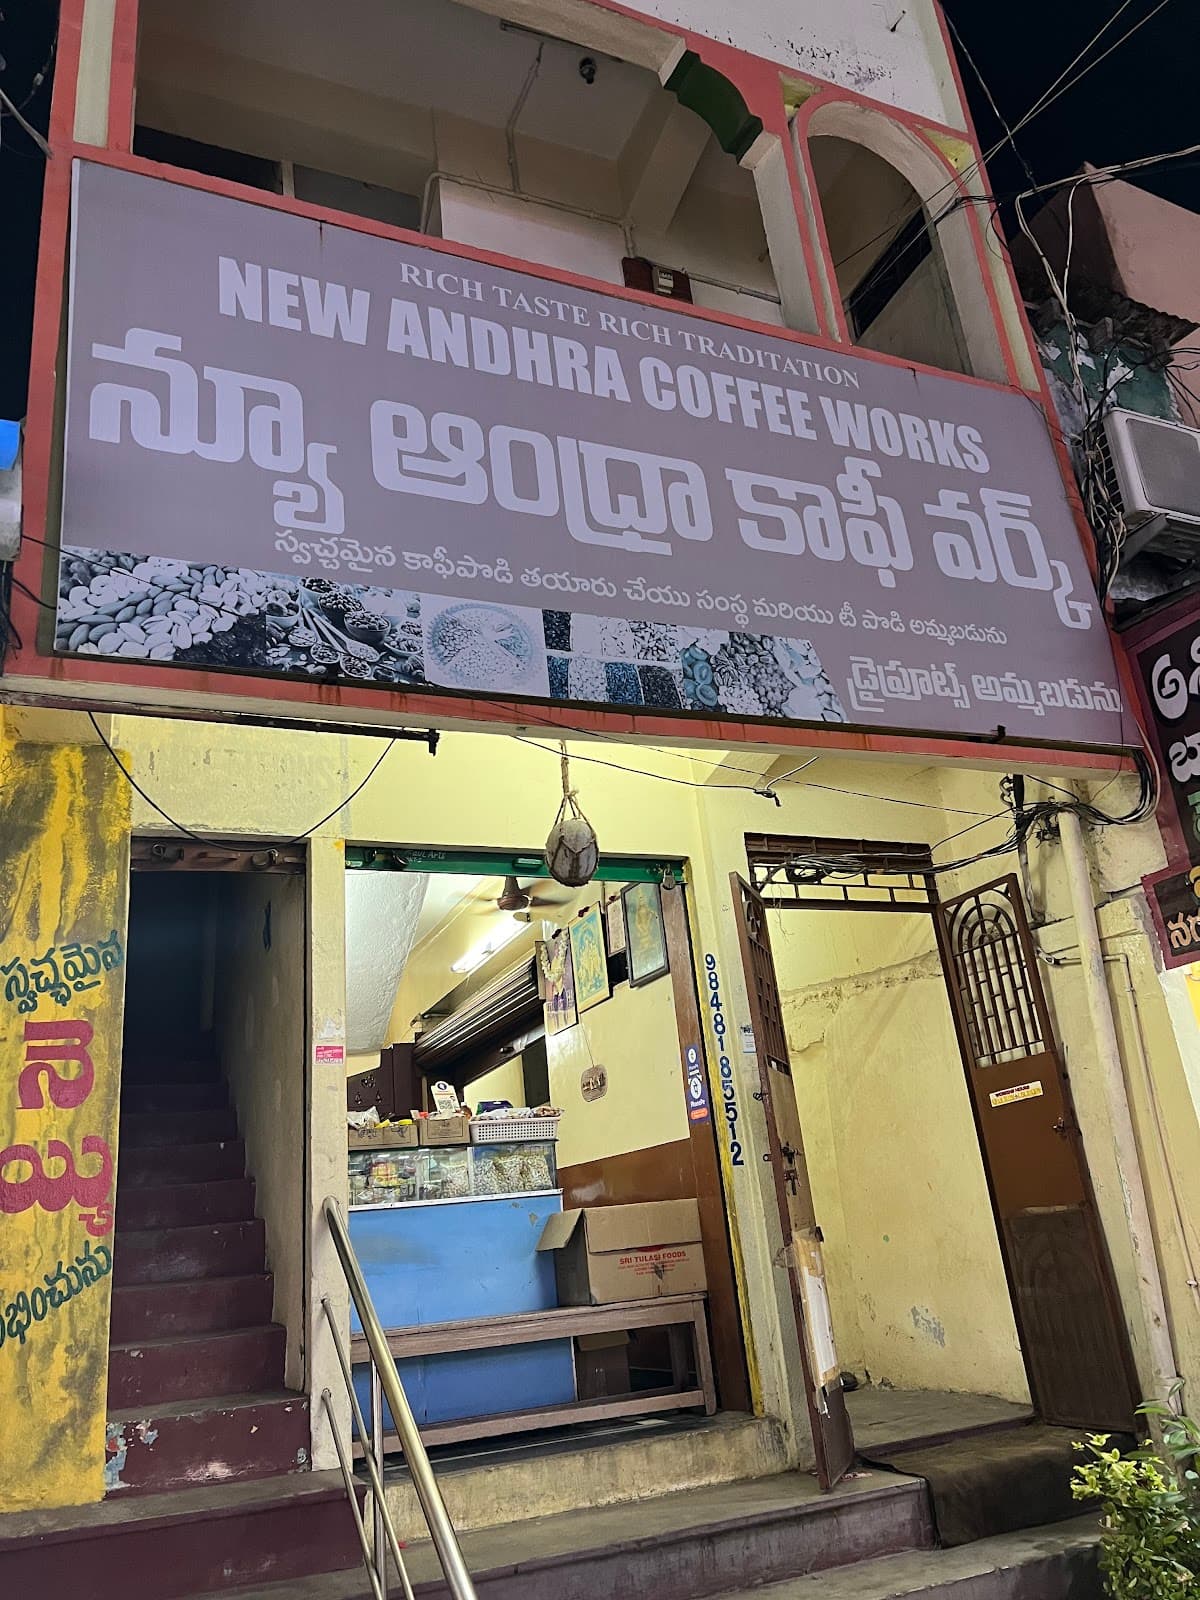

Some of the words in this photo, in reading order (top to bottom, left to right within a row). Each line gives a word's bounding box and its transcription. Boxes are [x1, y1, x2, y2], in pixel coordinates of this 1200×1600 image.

[218, 255, 370, 346] NEW
[387, 298, 632, 403] ANDHRA
[639, 356, 818, 441] COFFEE
[819, 396, 991, 474] WORKS
[400, 262, 484, 302] RICH
[492, 285, 591, 327] TASTE
[597, 311, 673, 347] RICH
[678, 330, 860, 390] TRADITATION
[725, 456, 914, 588] కాఫీ
[520, 567, 617, 598] తయారు
[623, 576, 691, 607] చేయు
[752, 598, 834, 625] మరియు
[862, 609, 906, 633] పొడి
[619, 1257, 632, 1265] SRI
[635, 1254, 661, 1263] TULASI
[662, 1251, 687, 1260] FOODS
